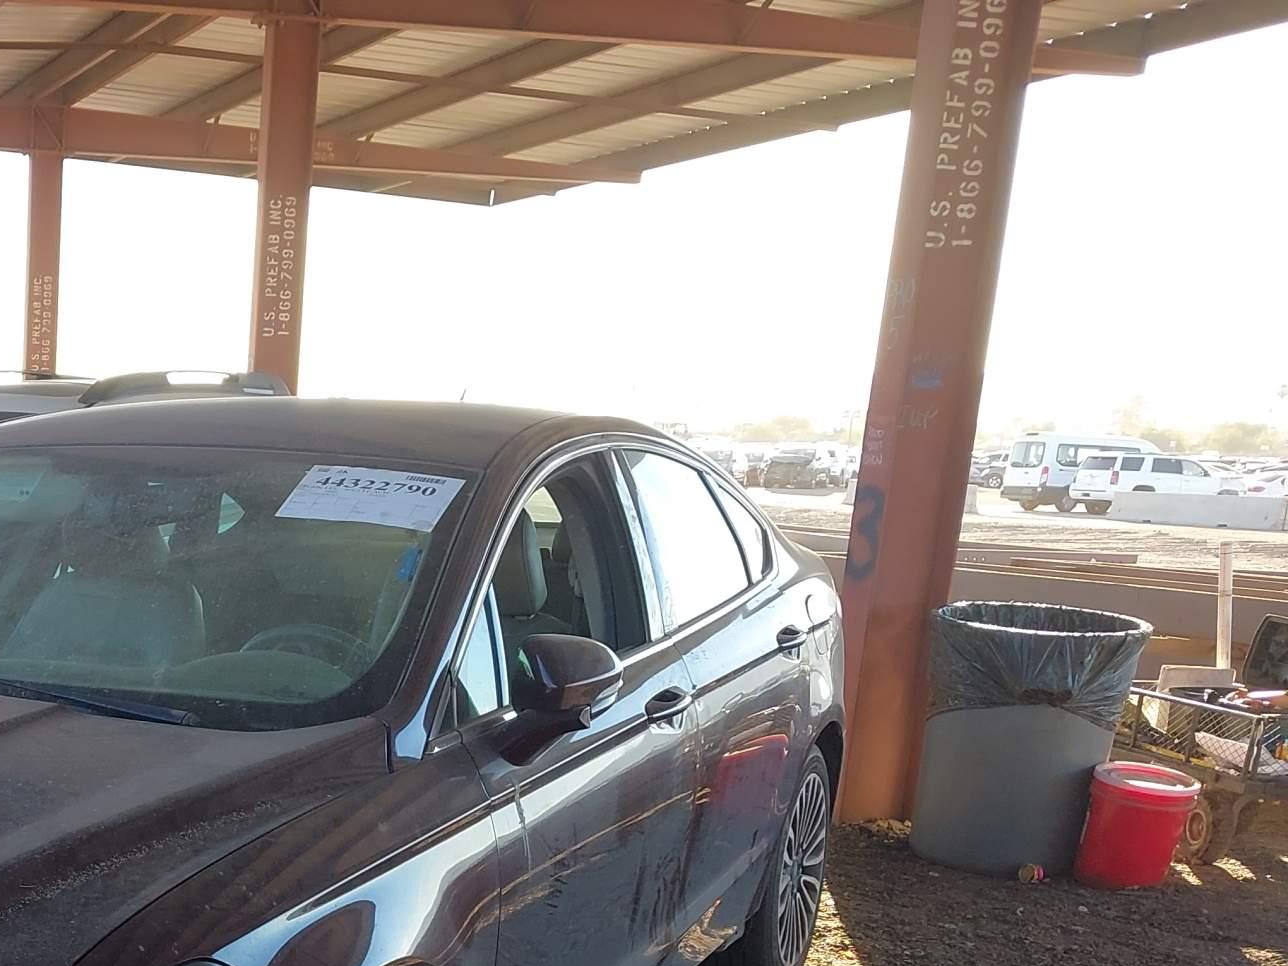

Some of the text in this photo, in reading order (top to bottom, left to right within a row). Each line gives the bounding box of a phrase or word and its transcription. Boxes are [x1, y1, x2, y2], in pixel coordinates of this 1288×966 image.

[936, 48, 972, 171] PREFAB
[262, 195, 283, 337] U.S. PREFAB INC.
[278, 196, 297, 336] 1-866-799-0969
[925, 191, 953, 248] U.S.
[32, 302, 42, 345] PREFAB
[315, 475, 437, 497] 44322790
[845, 484, 886, 582] 3
